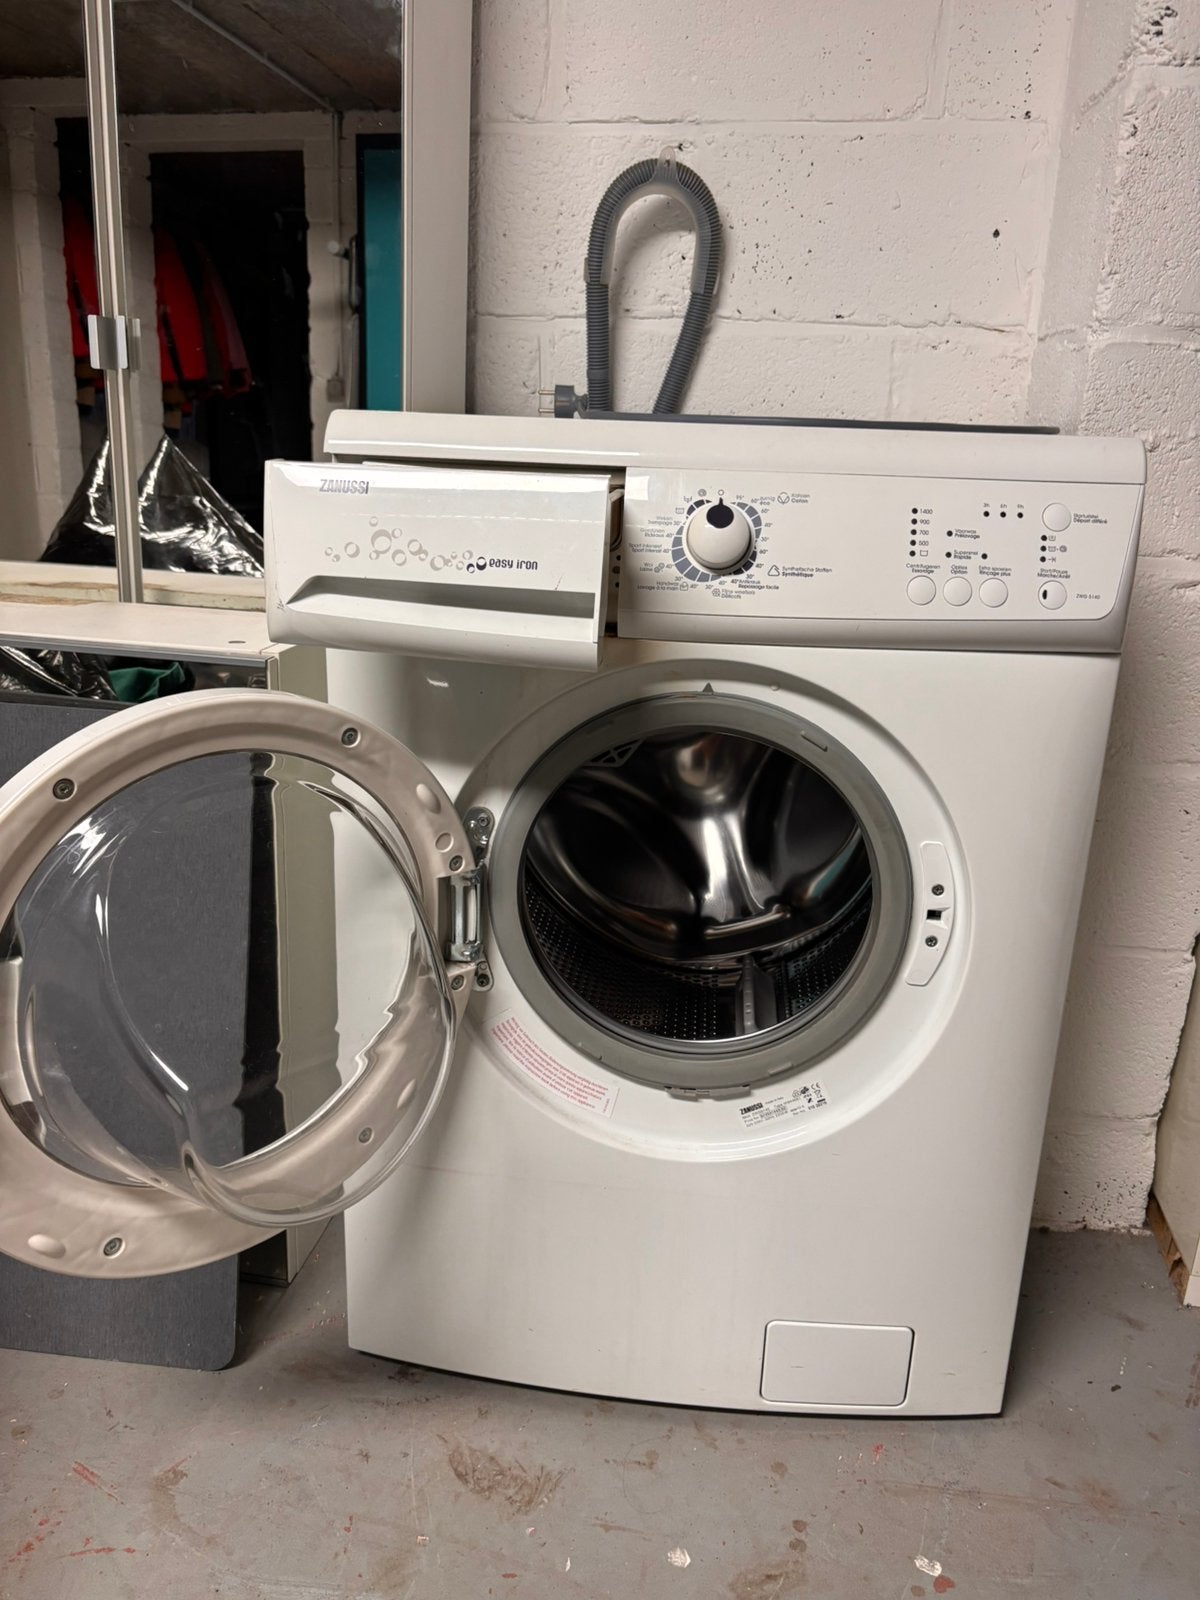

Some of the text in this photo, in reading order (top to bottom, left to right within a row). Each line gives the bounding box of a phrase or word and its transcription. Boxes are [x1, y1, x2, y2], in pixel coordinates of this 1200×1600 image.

[319, 479, 370, 494] ZANUSSI
[488, 558, 538, 570] easy iron
